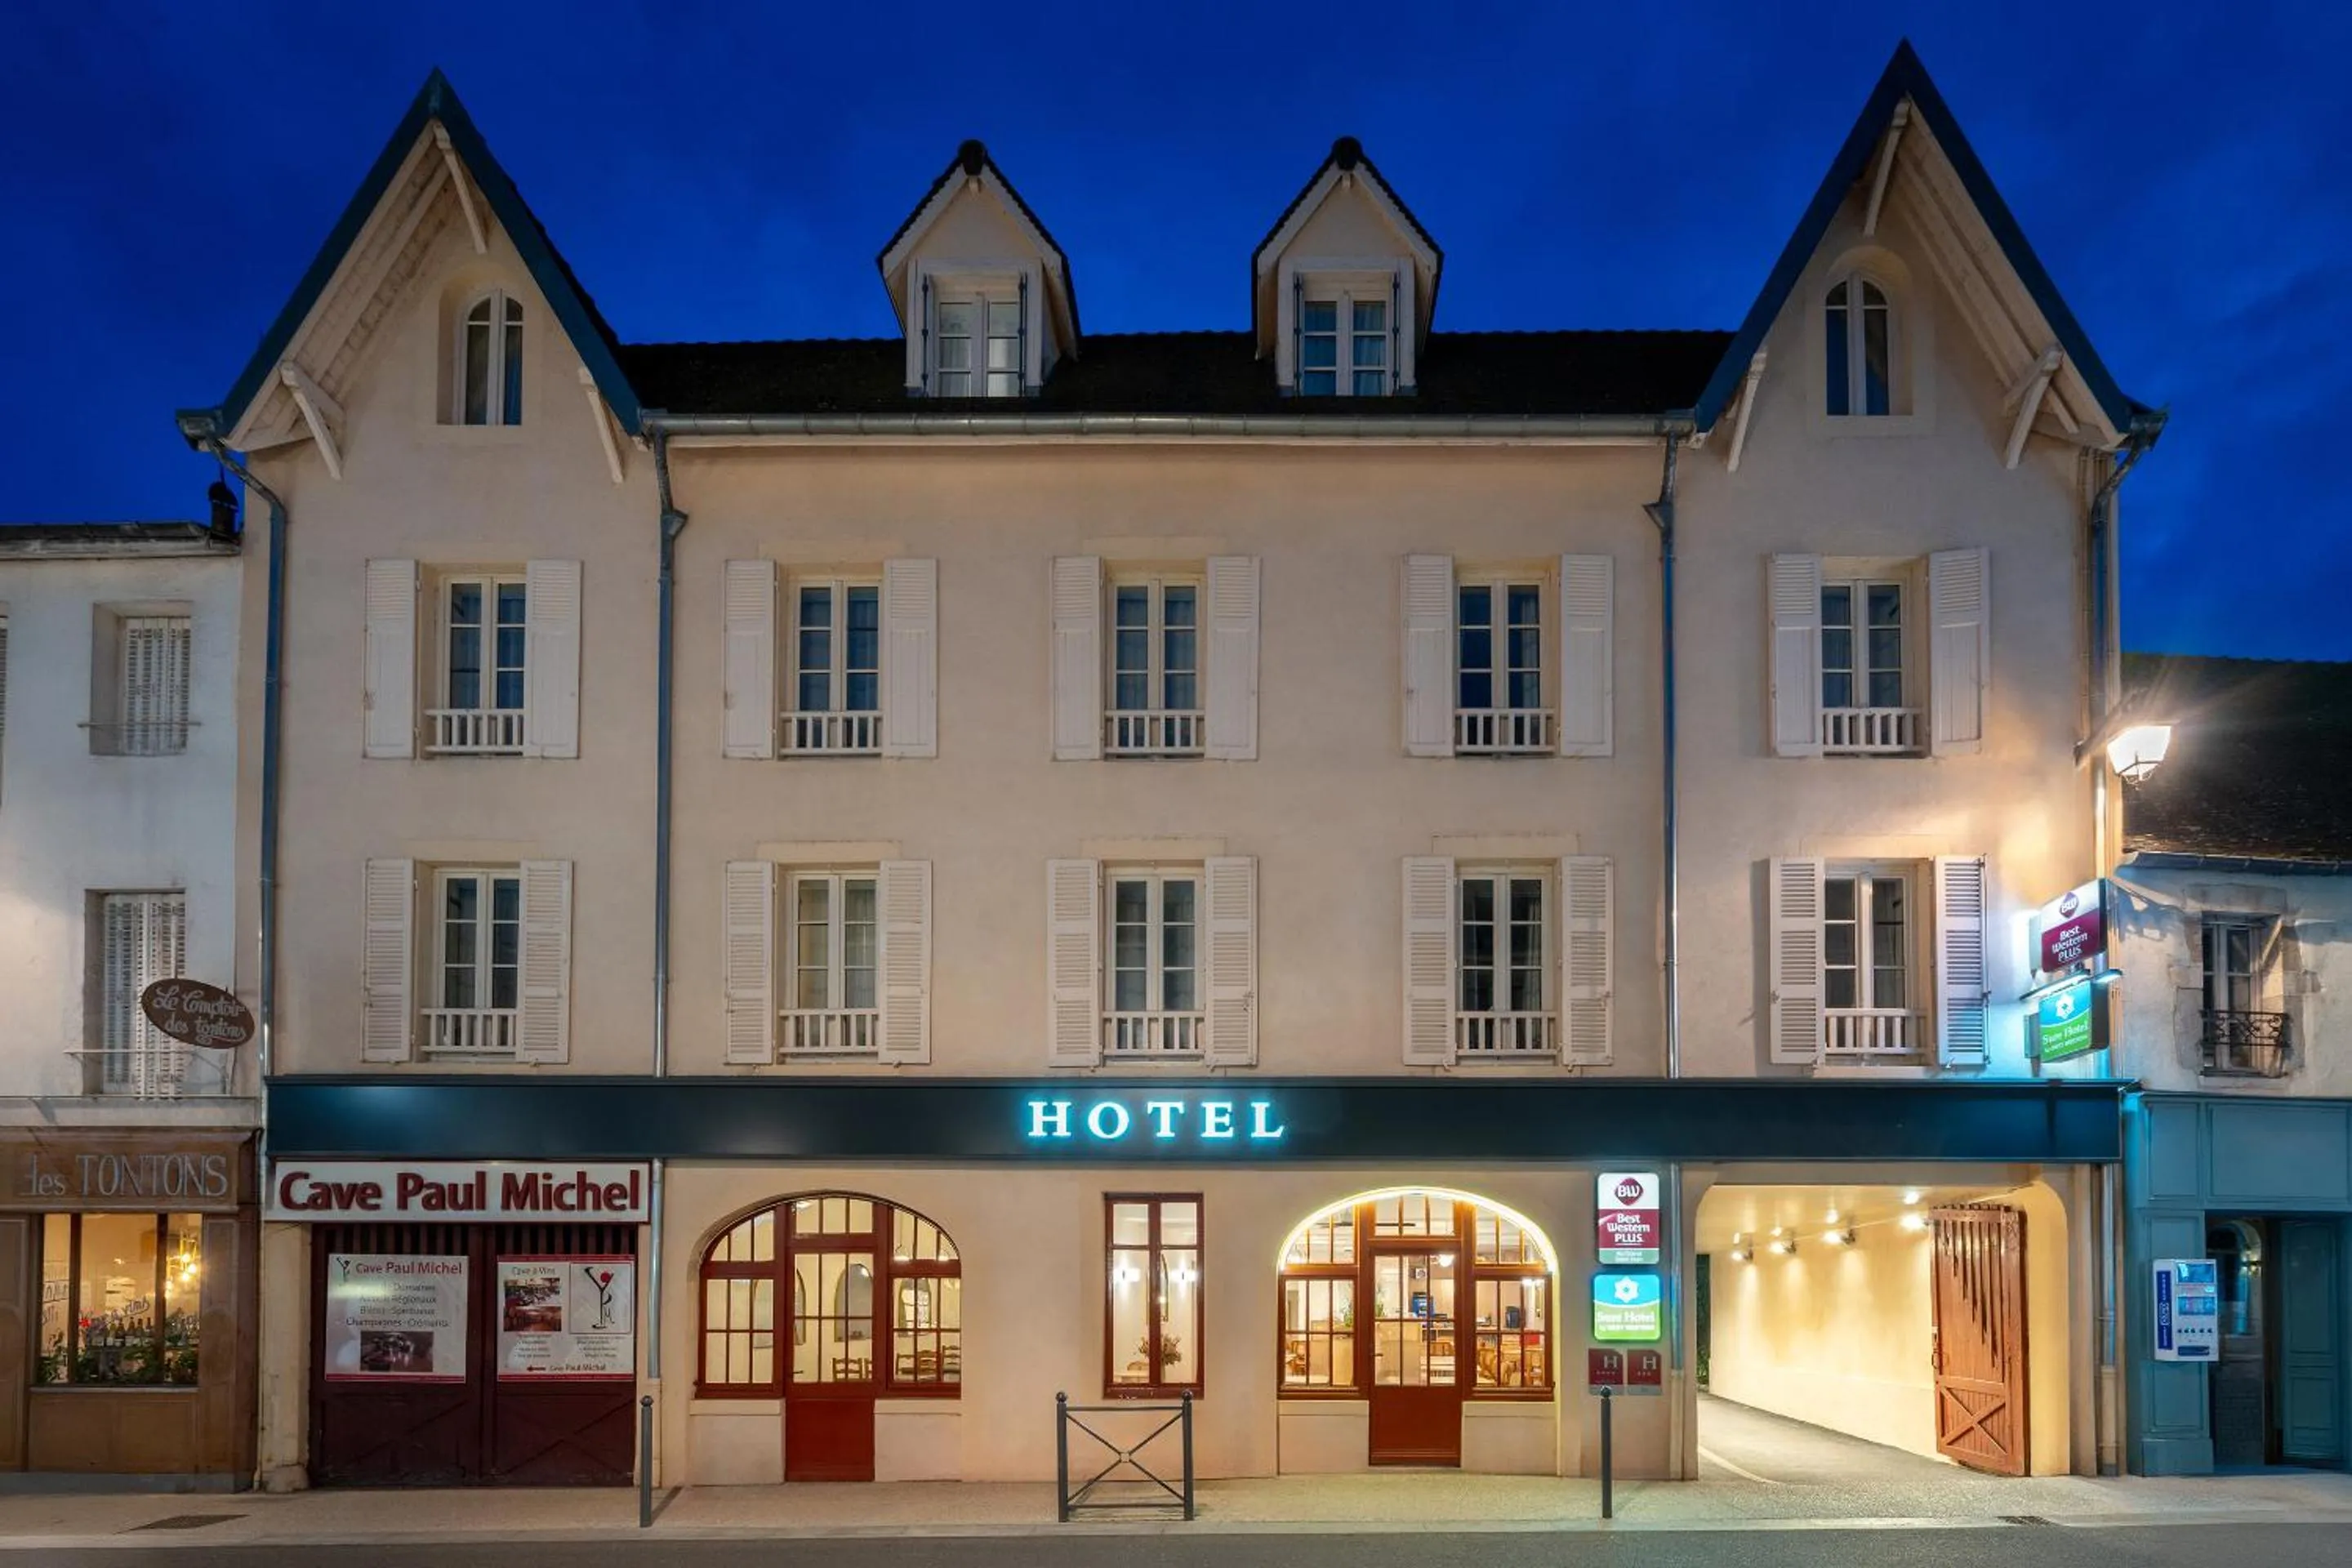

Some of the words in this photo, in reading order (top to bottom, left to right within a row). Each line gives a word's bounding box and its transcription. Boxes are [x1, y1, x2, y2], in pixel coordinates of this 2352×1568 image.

[2060, 925, 2081, 941] Best
[2051, 933, 2088, 954] Western
[2058, 944, 2082, 962] PLUS
[153, 984, 180, 1011] Le
[164, 1011, 189, 1034] des
[1027, 1101, 1285, 1139] HOTEL
[24, 1152, 66, 1196] les
[75, 1153, 229, 1197] TONTONS
[279, 1171, 382, 1212] Cave
[396, 1170, 488, 1212] Paul
[501, 1169, 640, 1212] Michel
[1617, 1184, 1641, 1198] BW
[1617, 1213, 1641, 1224] Best
[1606, 1223, 1650, 1233] Western
[1614, 1233, 1643, 1243] PLUS
[355, 1263, 384, 1274] Cave
[386, 1261, 415, 1275] Paul
[418, 1261, 462, 1275] Michel
[1603, 1355, 1618, 1369] H
[1642, 1356, 1657, 1370] H
